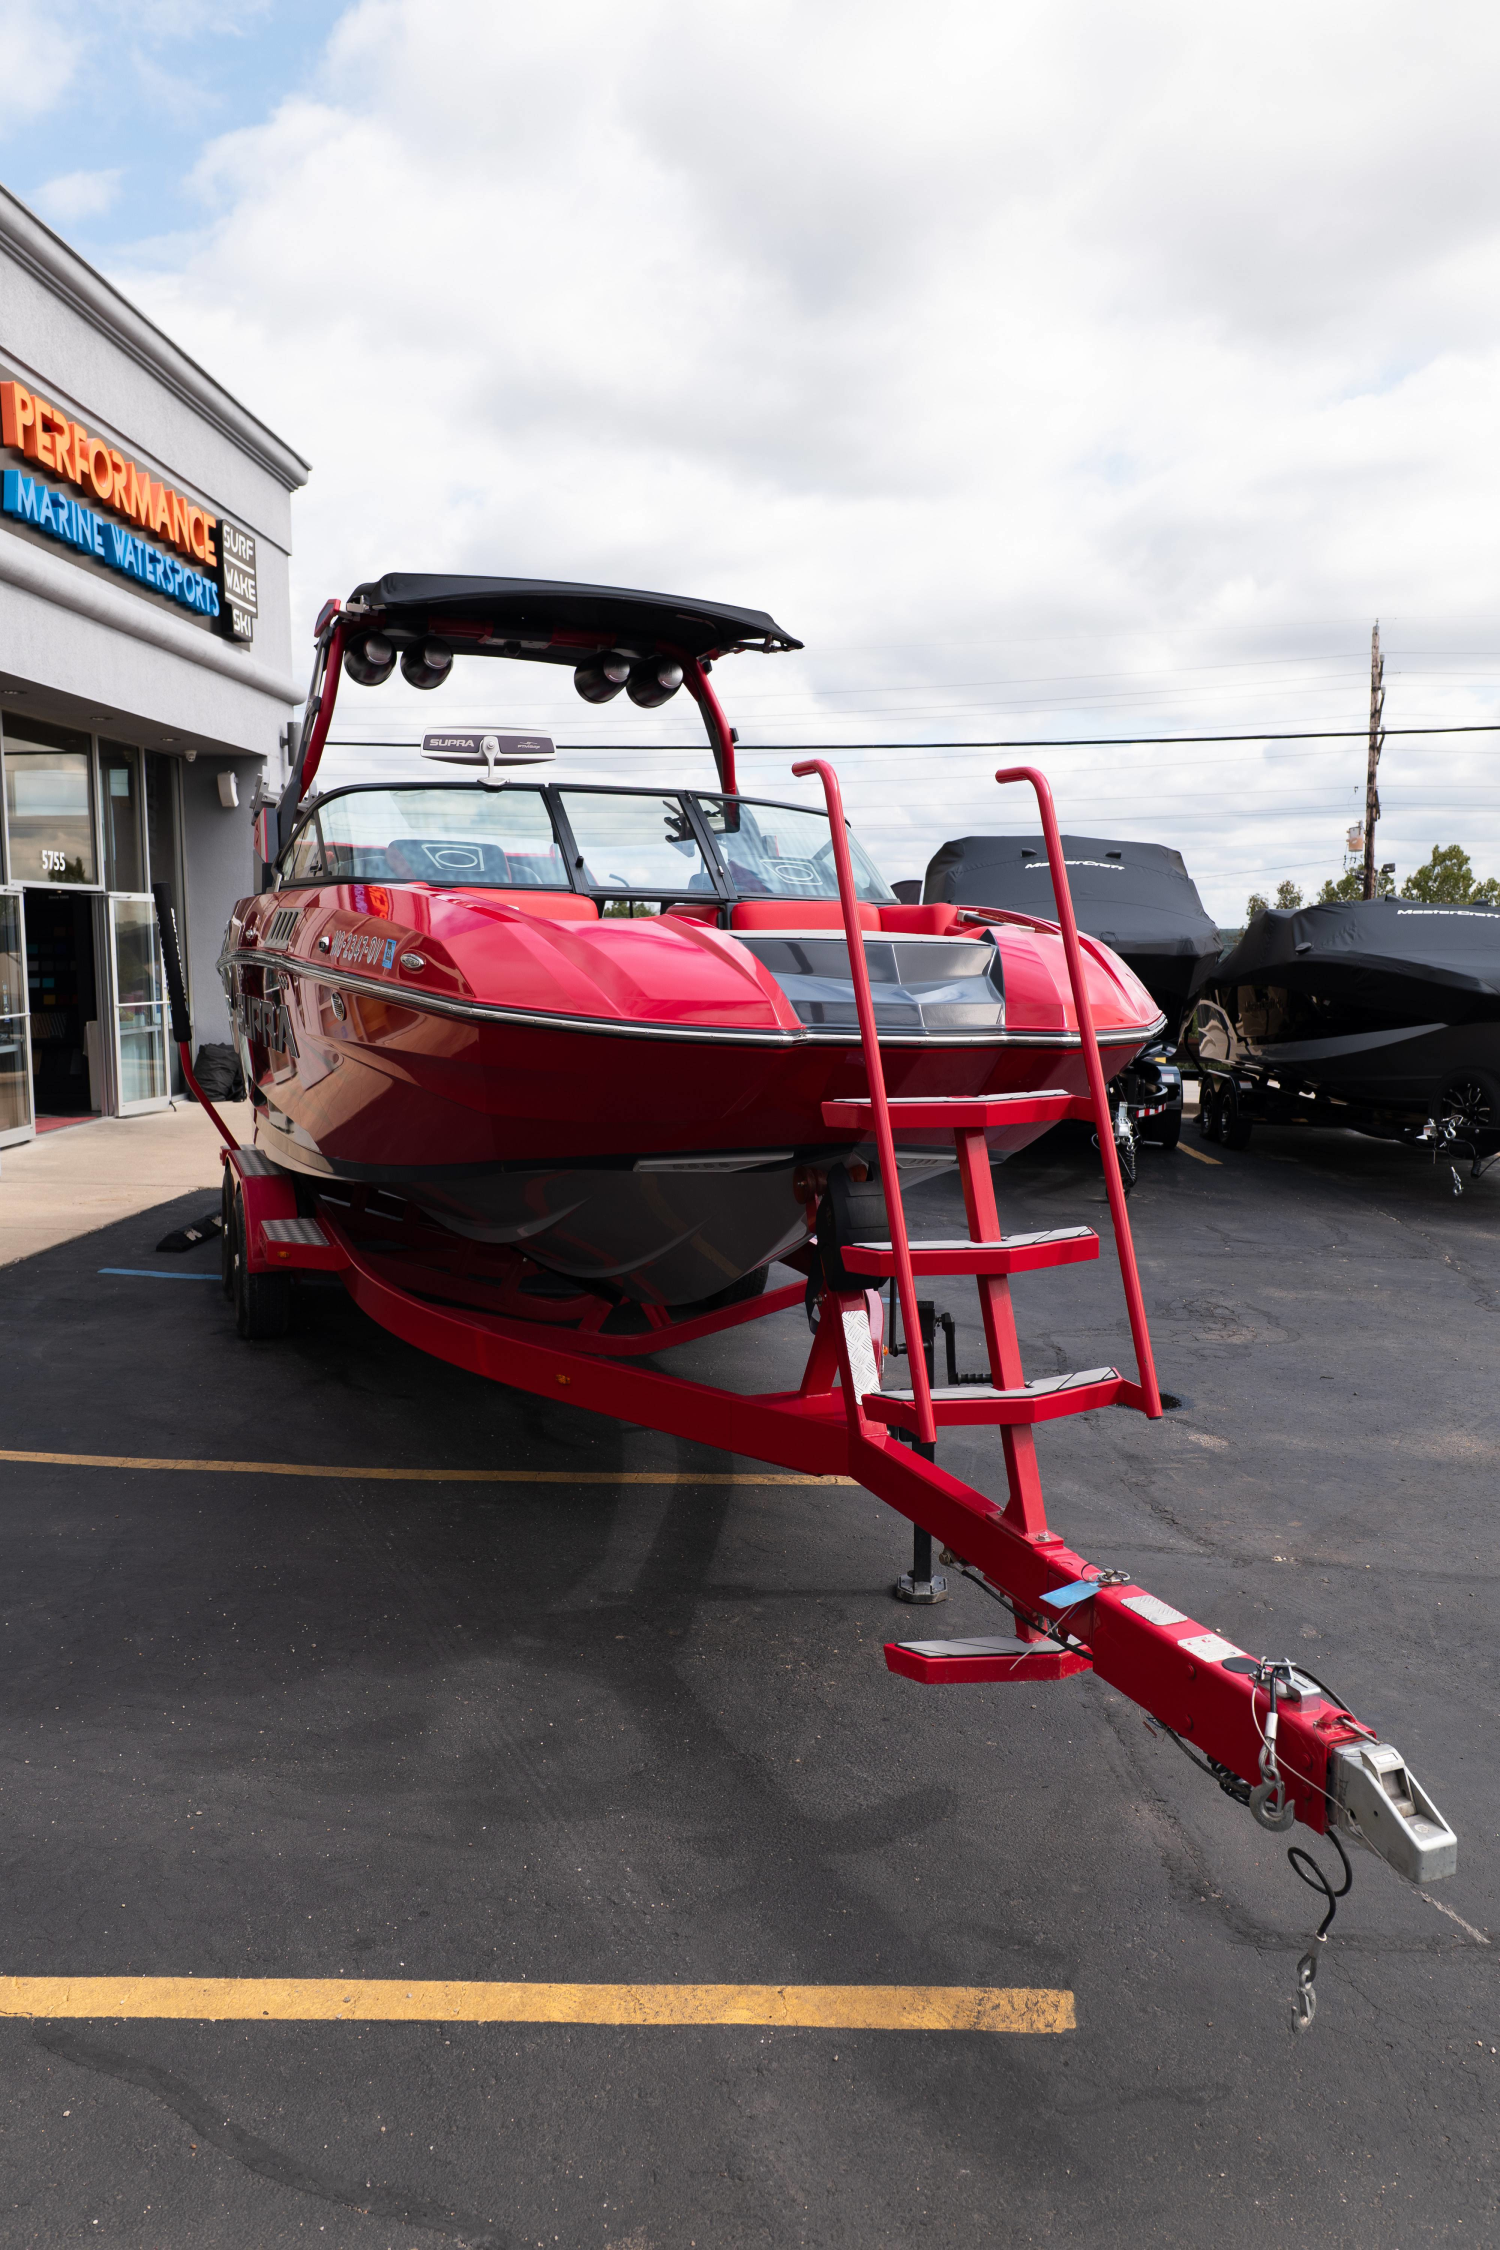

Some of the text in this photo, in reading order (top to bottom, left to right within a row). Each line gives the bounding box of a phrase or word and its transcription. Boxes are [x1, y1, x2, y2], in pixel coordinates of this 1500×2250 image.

[4, 380, 217, 568] PERFORMANCE
[14, 469, 221, 617] MARINE WATERSPORTS
[222, 524, 255, 562] SURF
[223, 563, 257, 602] WAKE
[232, 608, 252, 637] SKI
[429, 738, 475, 748] SUPRA
[42, 849, 66, 872] 5755
[235, 992, 300, 1059] SUPRA
